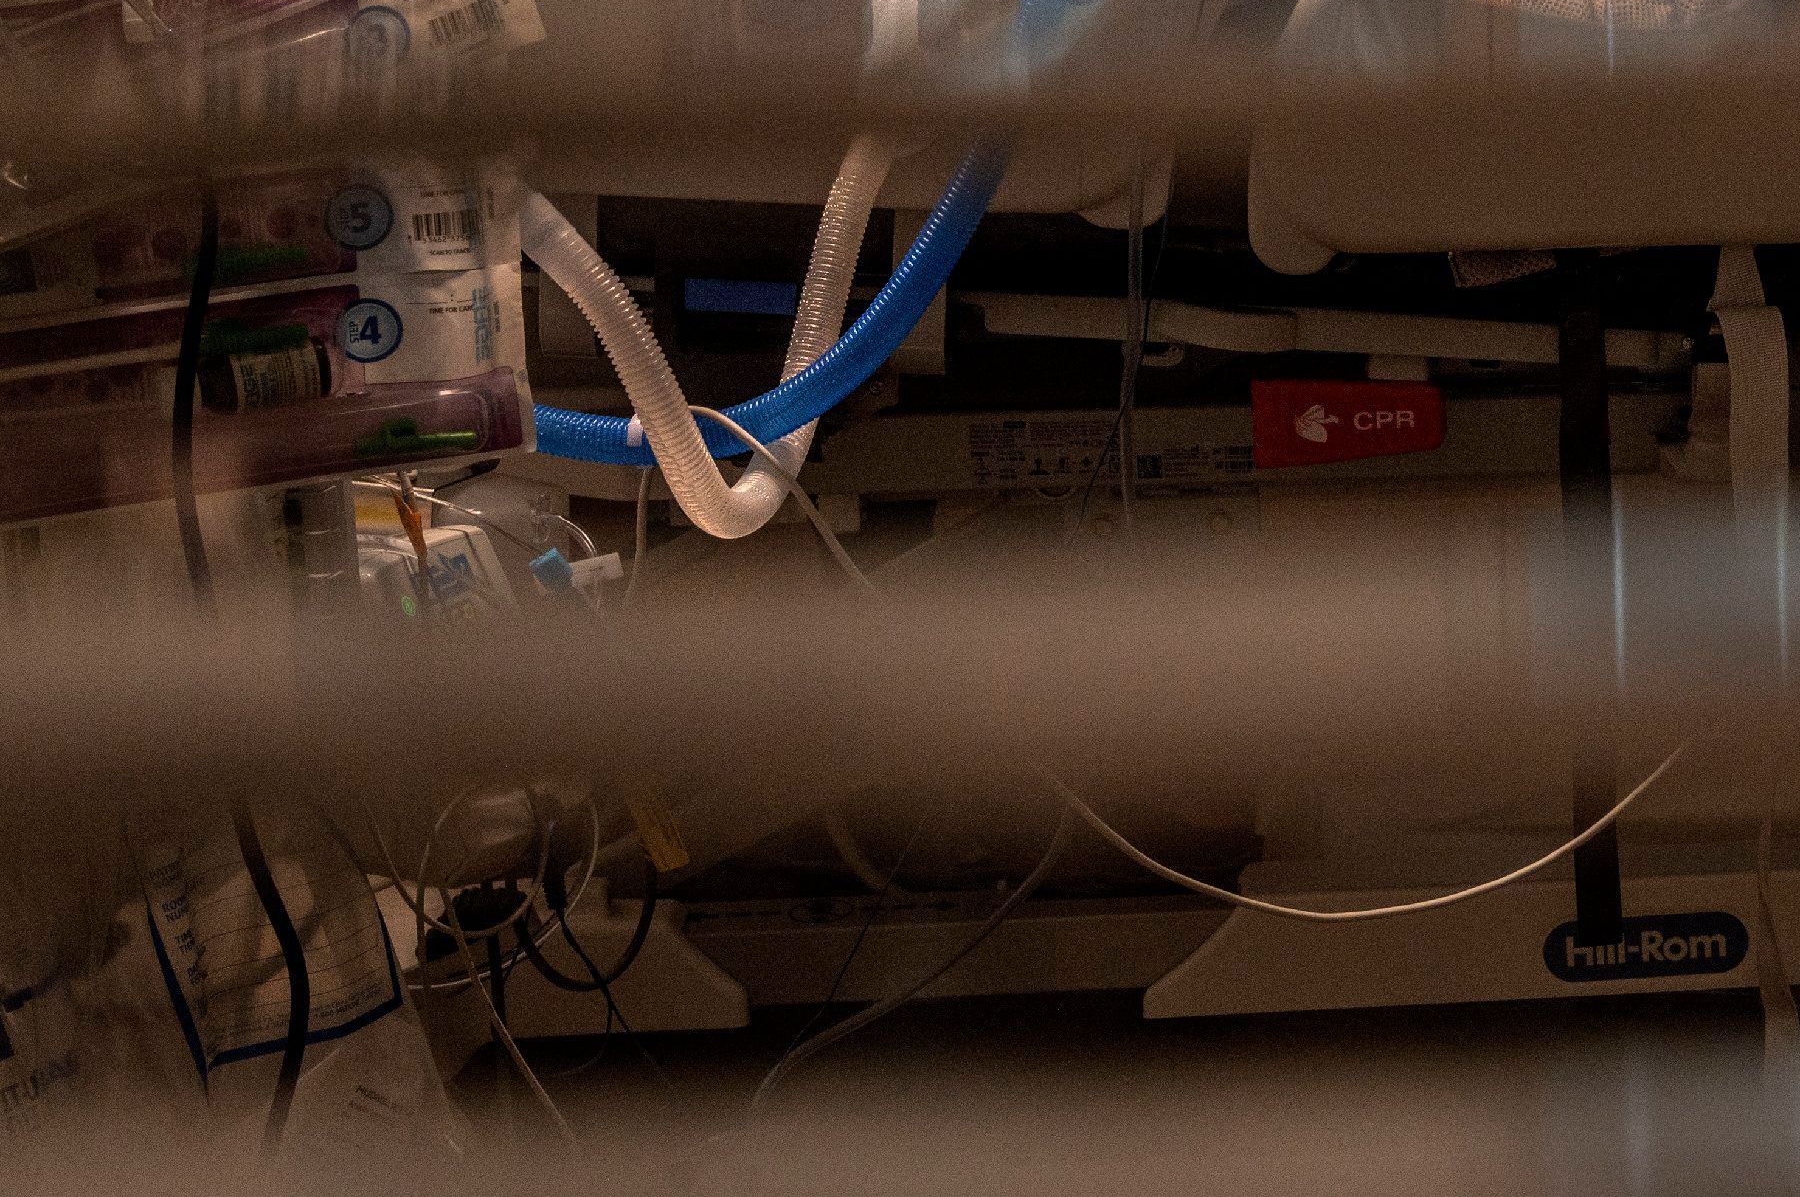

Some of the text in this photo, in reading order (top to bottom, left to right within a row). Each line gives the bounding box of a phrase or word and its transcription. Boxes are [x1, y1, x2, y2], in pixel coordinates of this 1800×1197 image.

[350, 202, 373, 234] 5
[359, 315, 382, 345] 4
[1352, 409, 1416, 432] CPR
[1565, 929, 1727, 968] Hill-Rom
